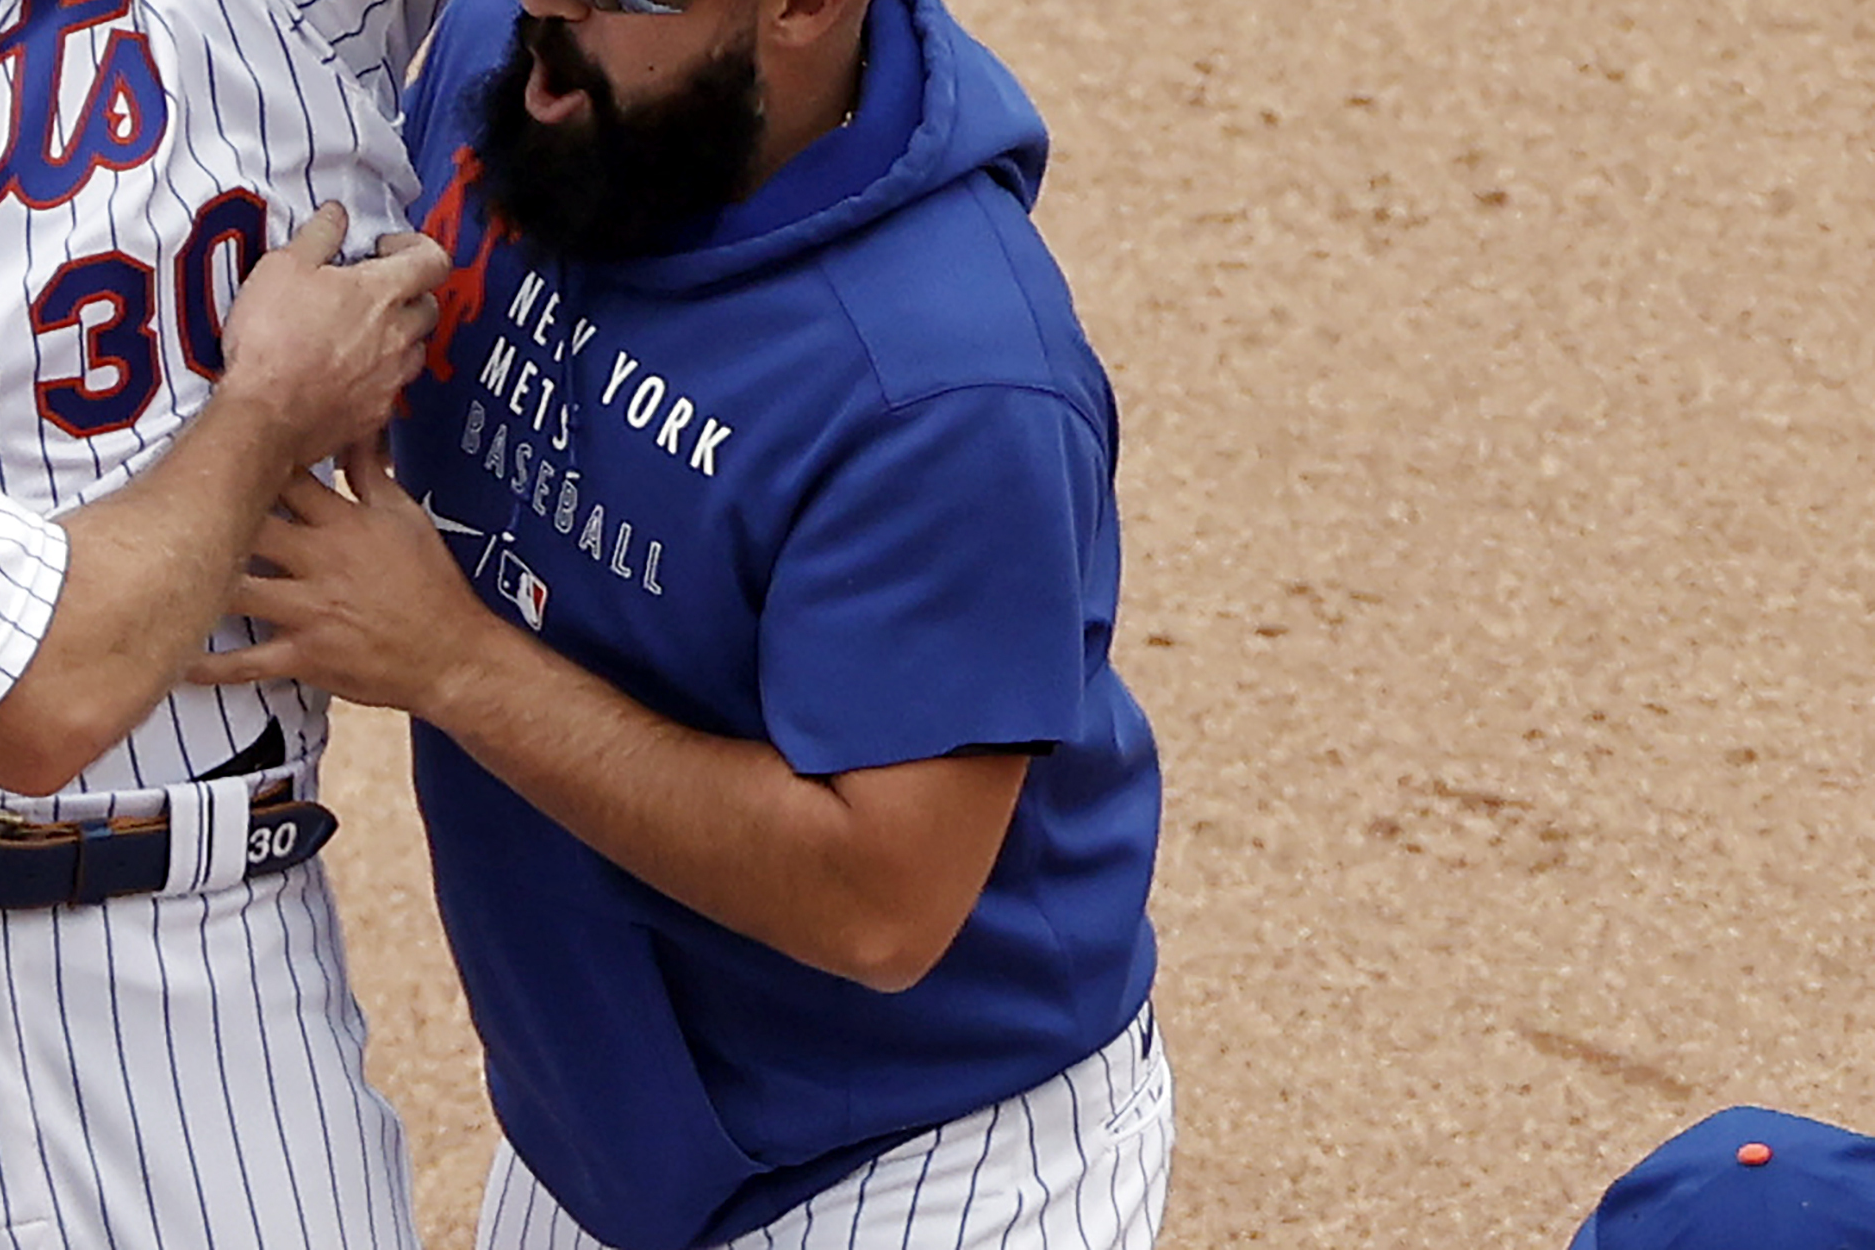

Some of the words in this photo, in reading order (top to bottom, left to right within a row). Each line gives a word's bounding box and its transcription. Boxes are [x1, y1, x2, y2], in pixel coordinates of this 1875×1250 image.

[29, 185, 267, 439] 30
[601, 350, 732, 477] YORK
[461, 400, 663, 595] BASEBALL
[247, 821, 297, 864] 30
